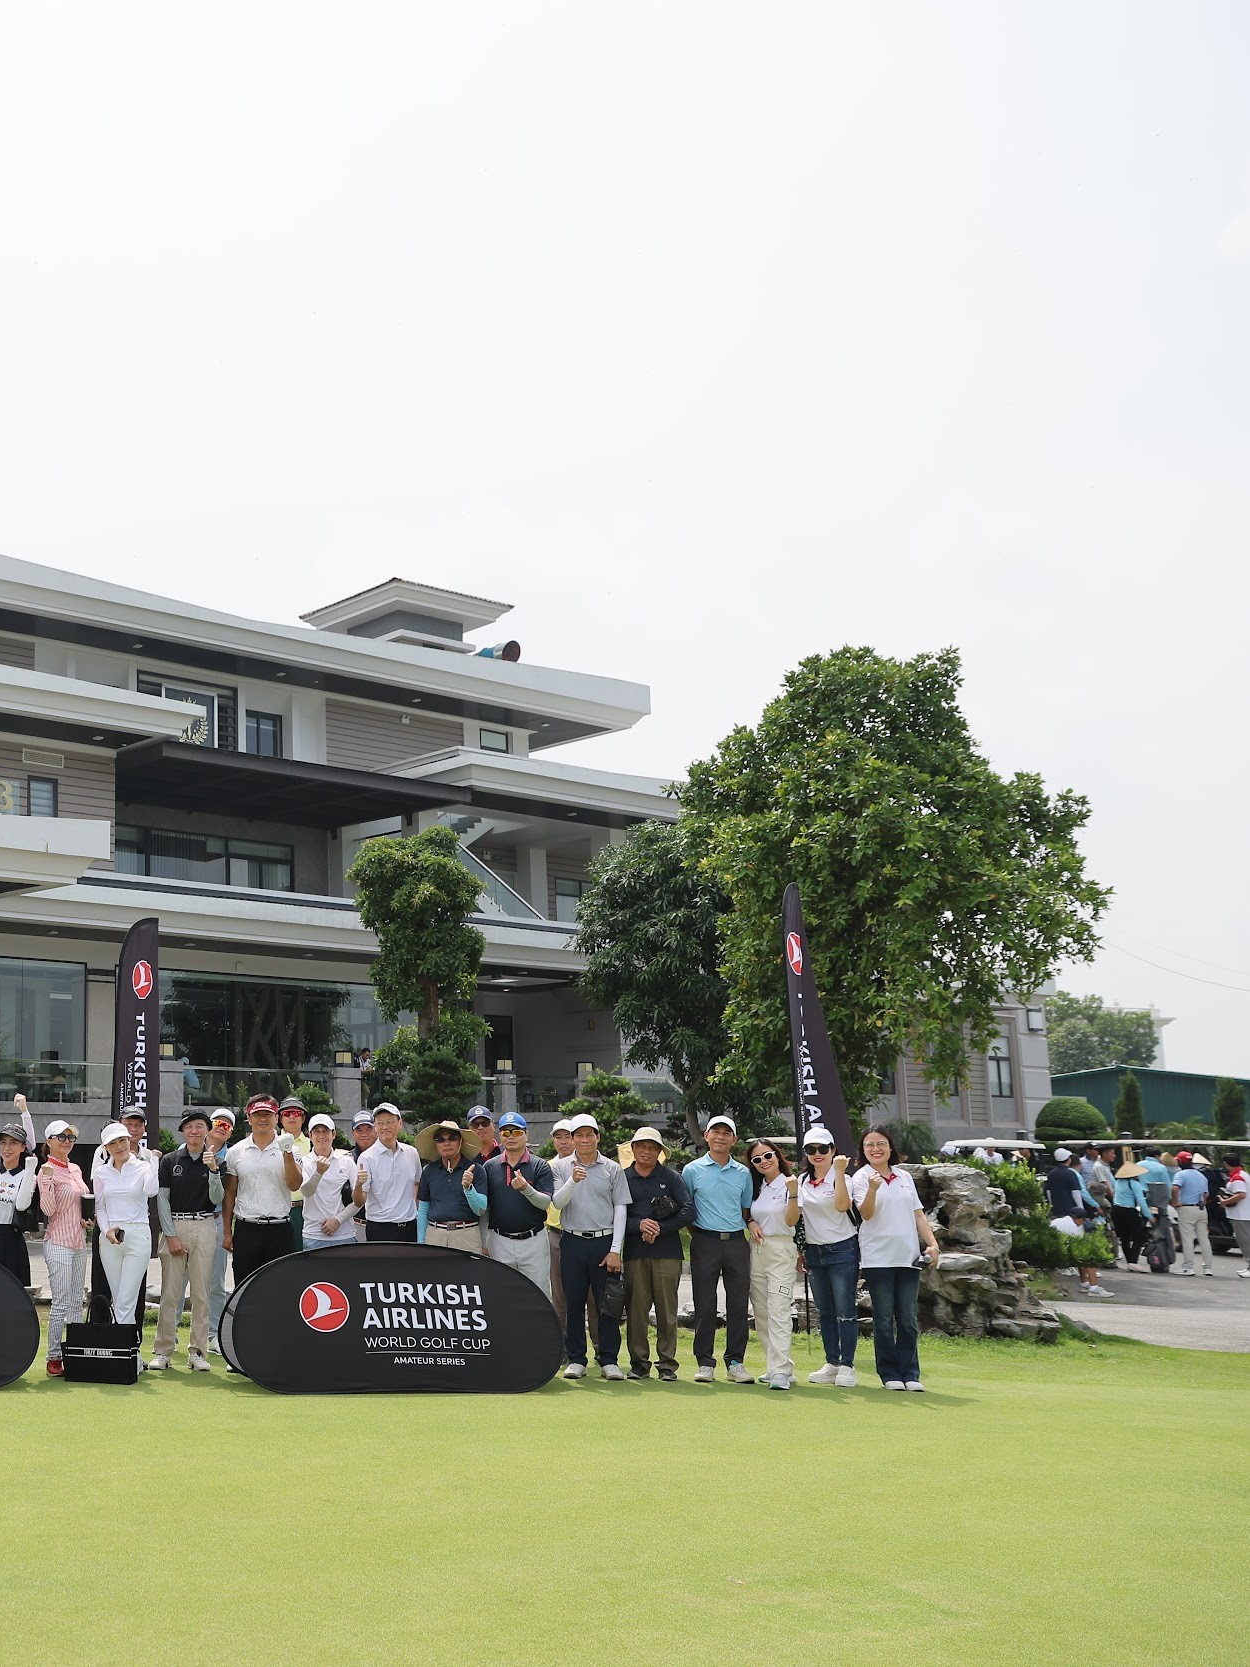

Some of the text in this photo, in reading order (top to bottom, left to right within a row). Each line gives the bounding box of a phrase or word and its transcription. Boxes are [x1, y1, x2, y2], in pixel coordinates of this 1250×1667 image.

[134, 1012, 147, 1107] TURKISH
[125, 1061, 134, 1103] WORLD
[359, 1282, 483, 1306] TURKISH
[362, 1307, 488, 1331] AIRLINES
[364, 1336, 491, 1350] WORLD GOLF CUP
[393, 1356, 466, 1366] AMATEUR SERIES
